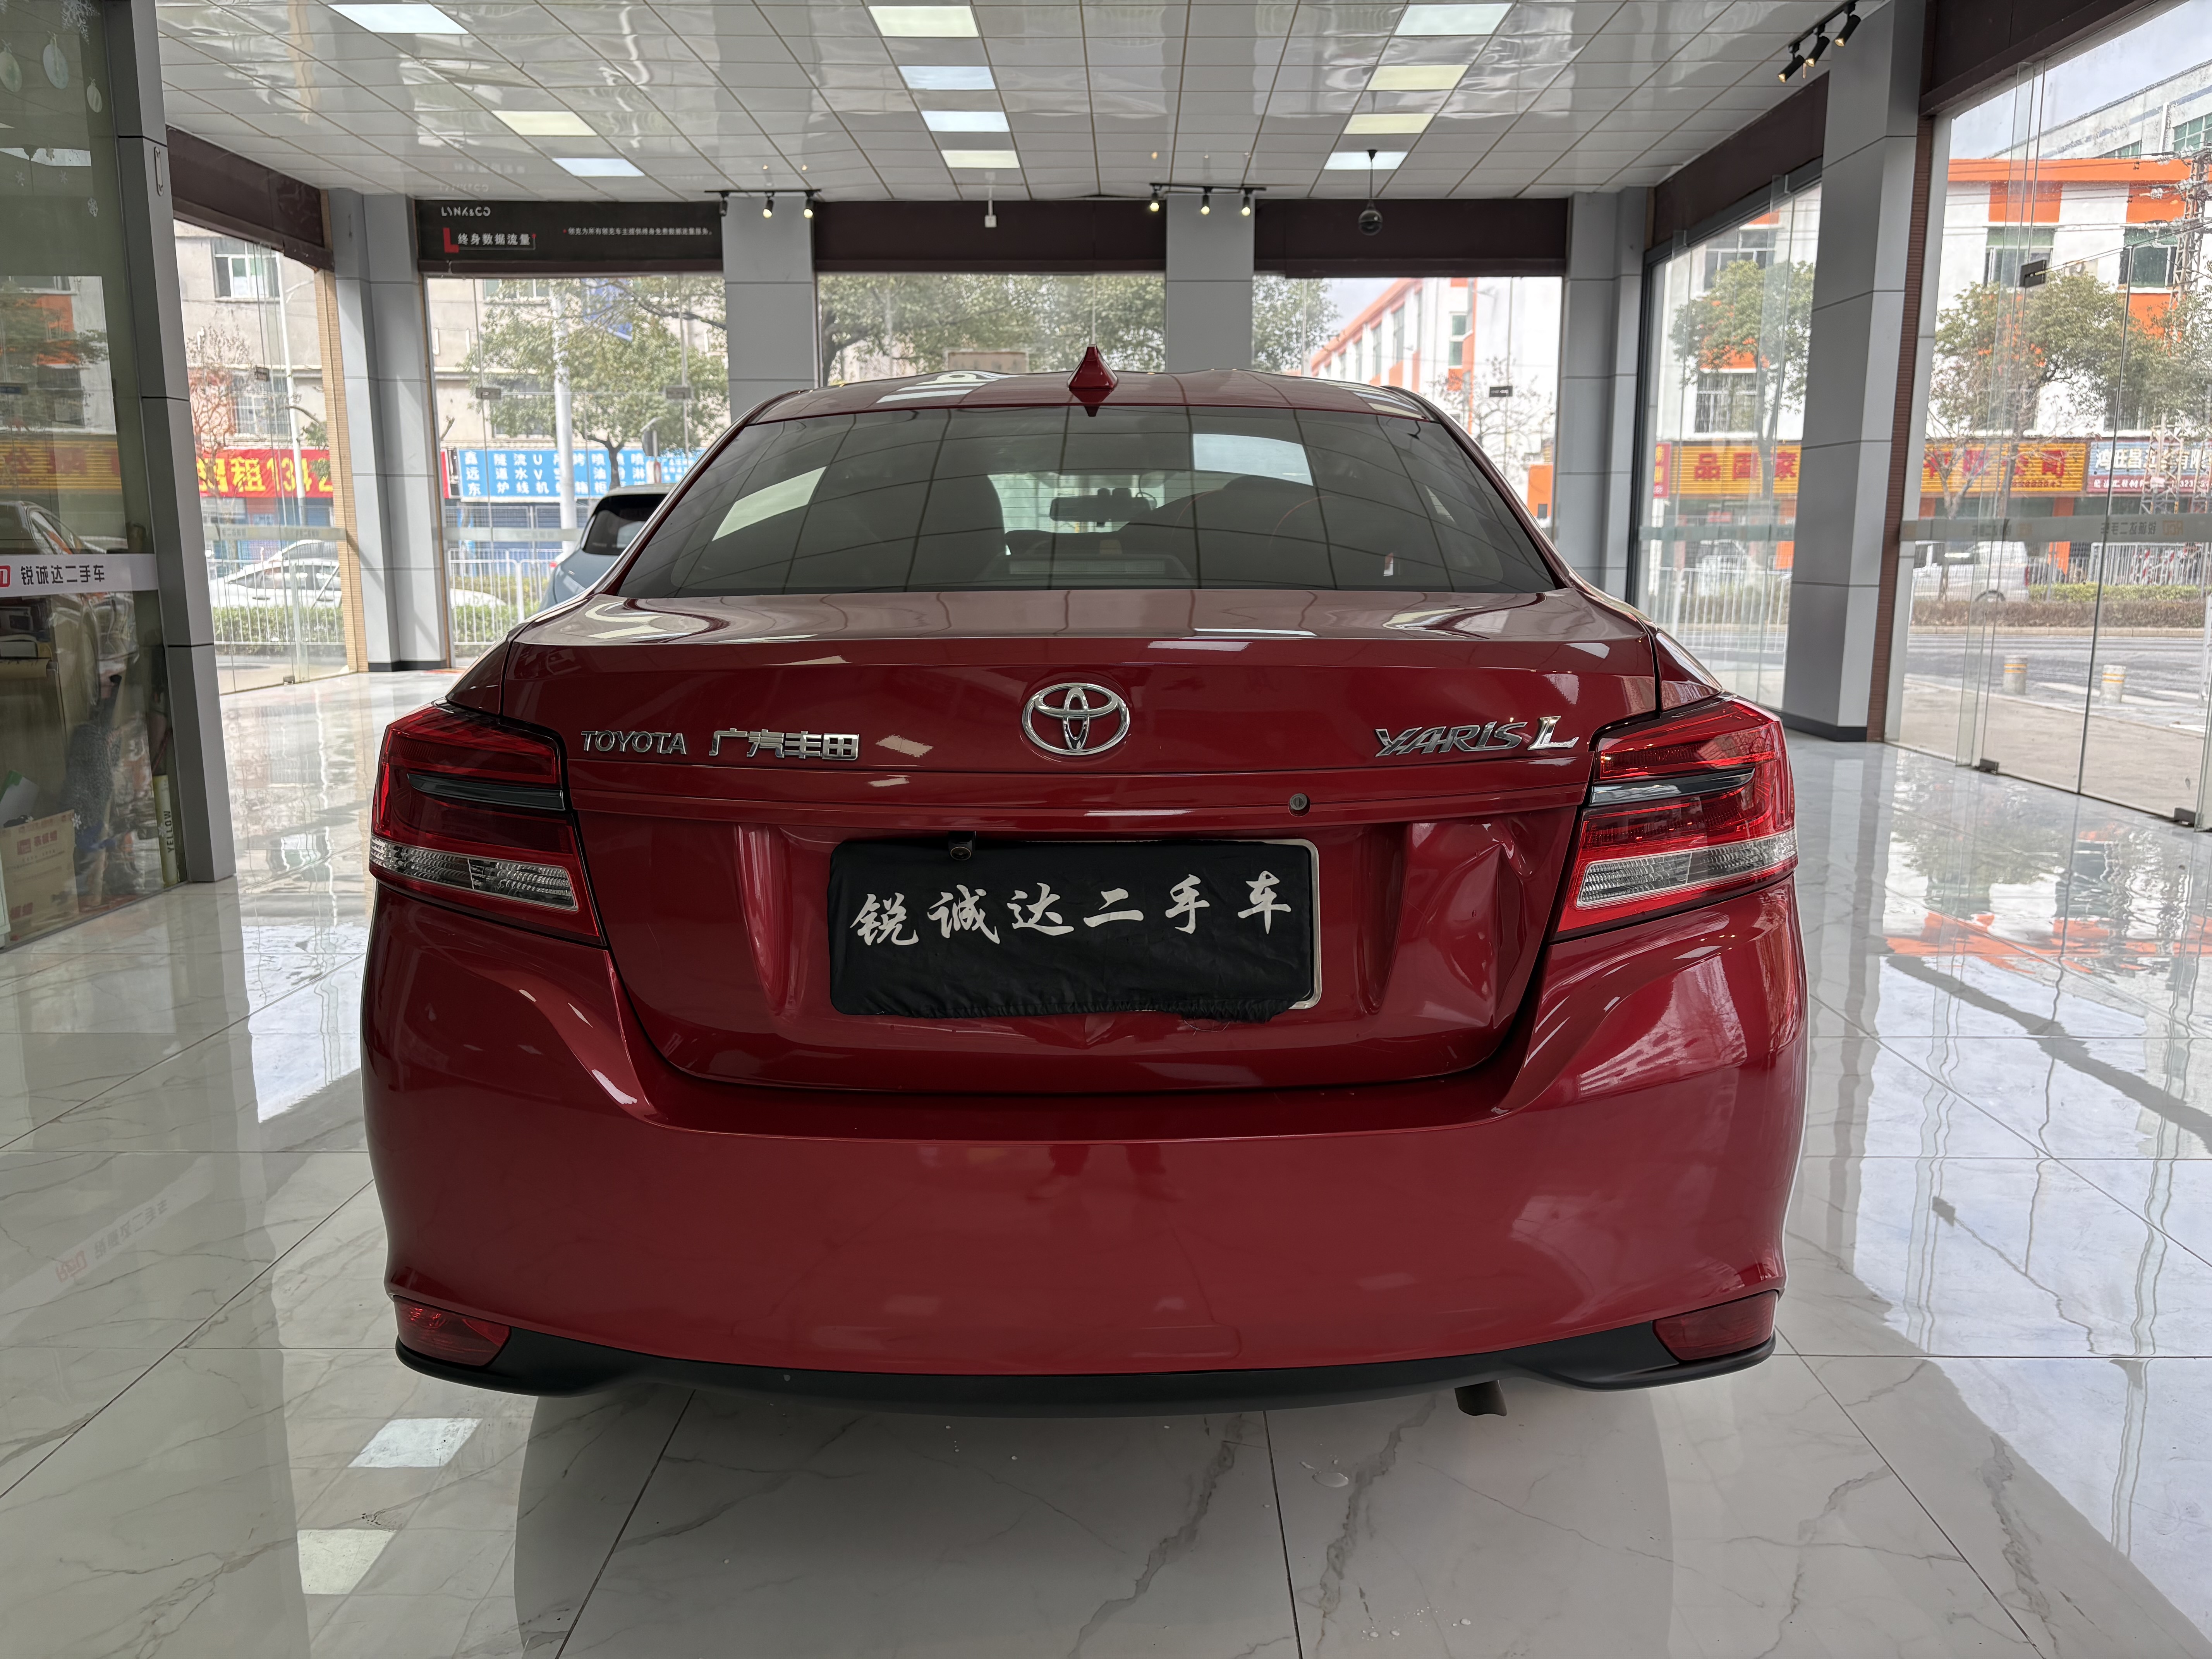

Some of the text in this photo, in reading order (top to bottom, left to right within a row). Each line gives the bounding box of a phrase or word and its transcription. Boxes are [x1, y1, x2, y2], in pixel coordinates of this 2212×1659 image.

[458, 233, 530, 246] 终身数据流量
[21, 565, 105, 585] 锐诚达二手车
[581, 728, 859, 761] TOYOTA 广汽丰田
[1527, 715, 1580, 750] L
[164, 811, 175, 853] YELLOW
[850, 870, 1291, 946] 锐诚达二手车
